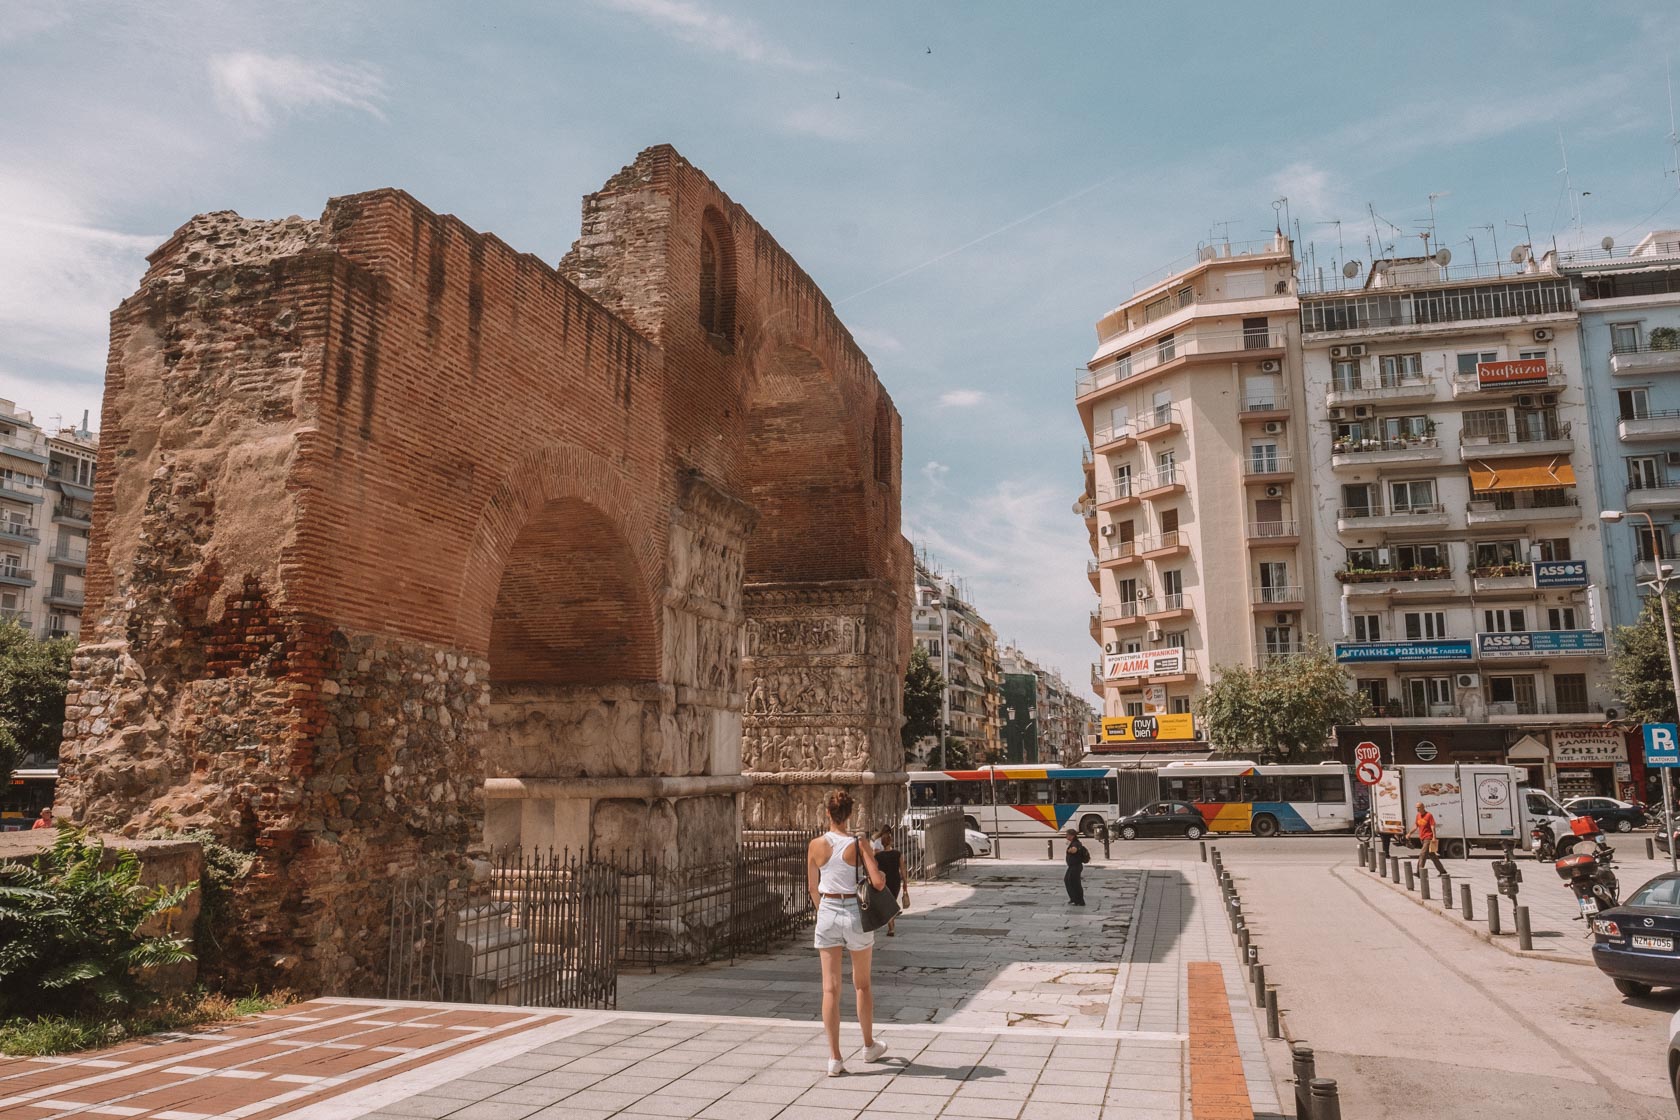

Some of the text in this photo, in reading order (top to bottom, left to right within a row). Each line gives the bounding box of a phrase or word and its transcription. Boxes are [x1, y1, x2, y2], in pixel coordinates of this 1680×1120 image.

[1480, 363, 1545, 378] διαβάζω
[1539, 565, 1584, 576] ASSOS
[1483, 636, 1530, 646] ASSOS
[1142, 649, 1179, 658] ΓΕΡΜΑΝΙΚΩΝ
[1340, 648, 1389, 657] ΑΓΓΛΙΚΗΣ
[1395, 647, 1439, 656] ΡΩΣΙΚΗΣ
[1122, 660, 1149, 672] ΑΛΜΑ
[1134, 719, 1151, 730] muy
[1555, 730, 1620, 739] ΜΠΟΥΓΑΤΣΑ
[1357, 747, 1378, 760] STOP
[1652, 937, 1671, 948] 7056
